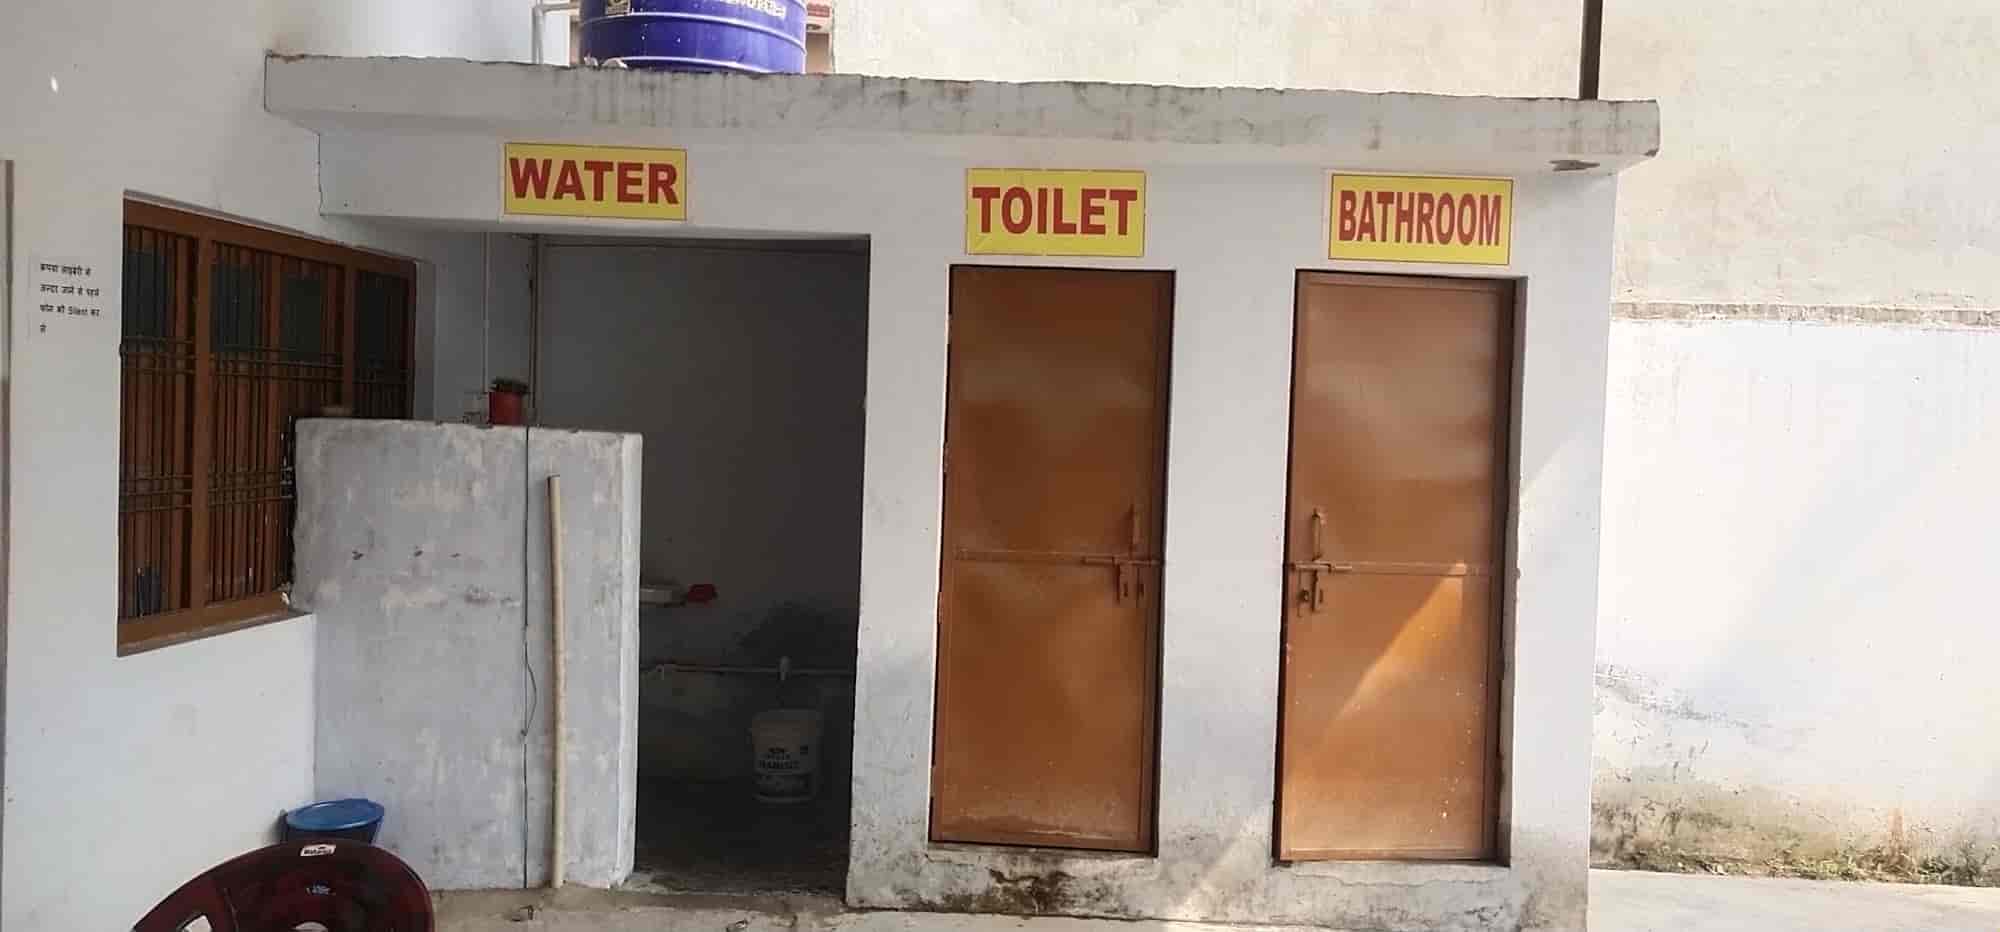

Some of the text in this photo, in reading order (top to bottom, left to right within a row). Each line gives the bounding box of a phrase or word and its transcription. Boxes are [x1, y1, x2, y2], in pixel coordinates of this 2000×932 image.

[509, 158, 679, 205] WATER
[972, 186, 1138, 236] TOILET
[1338, 190, 1502, 247] BATHROOM
